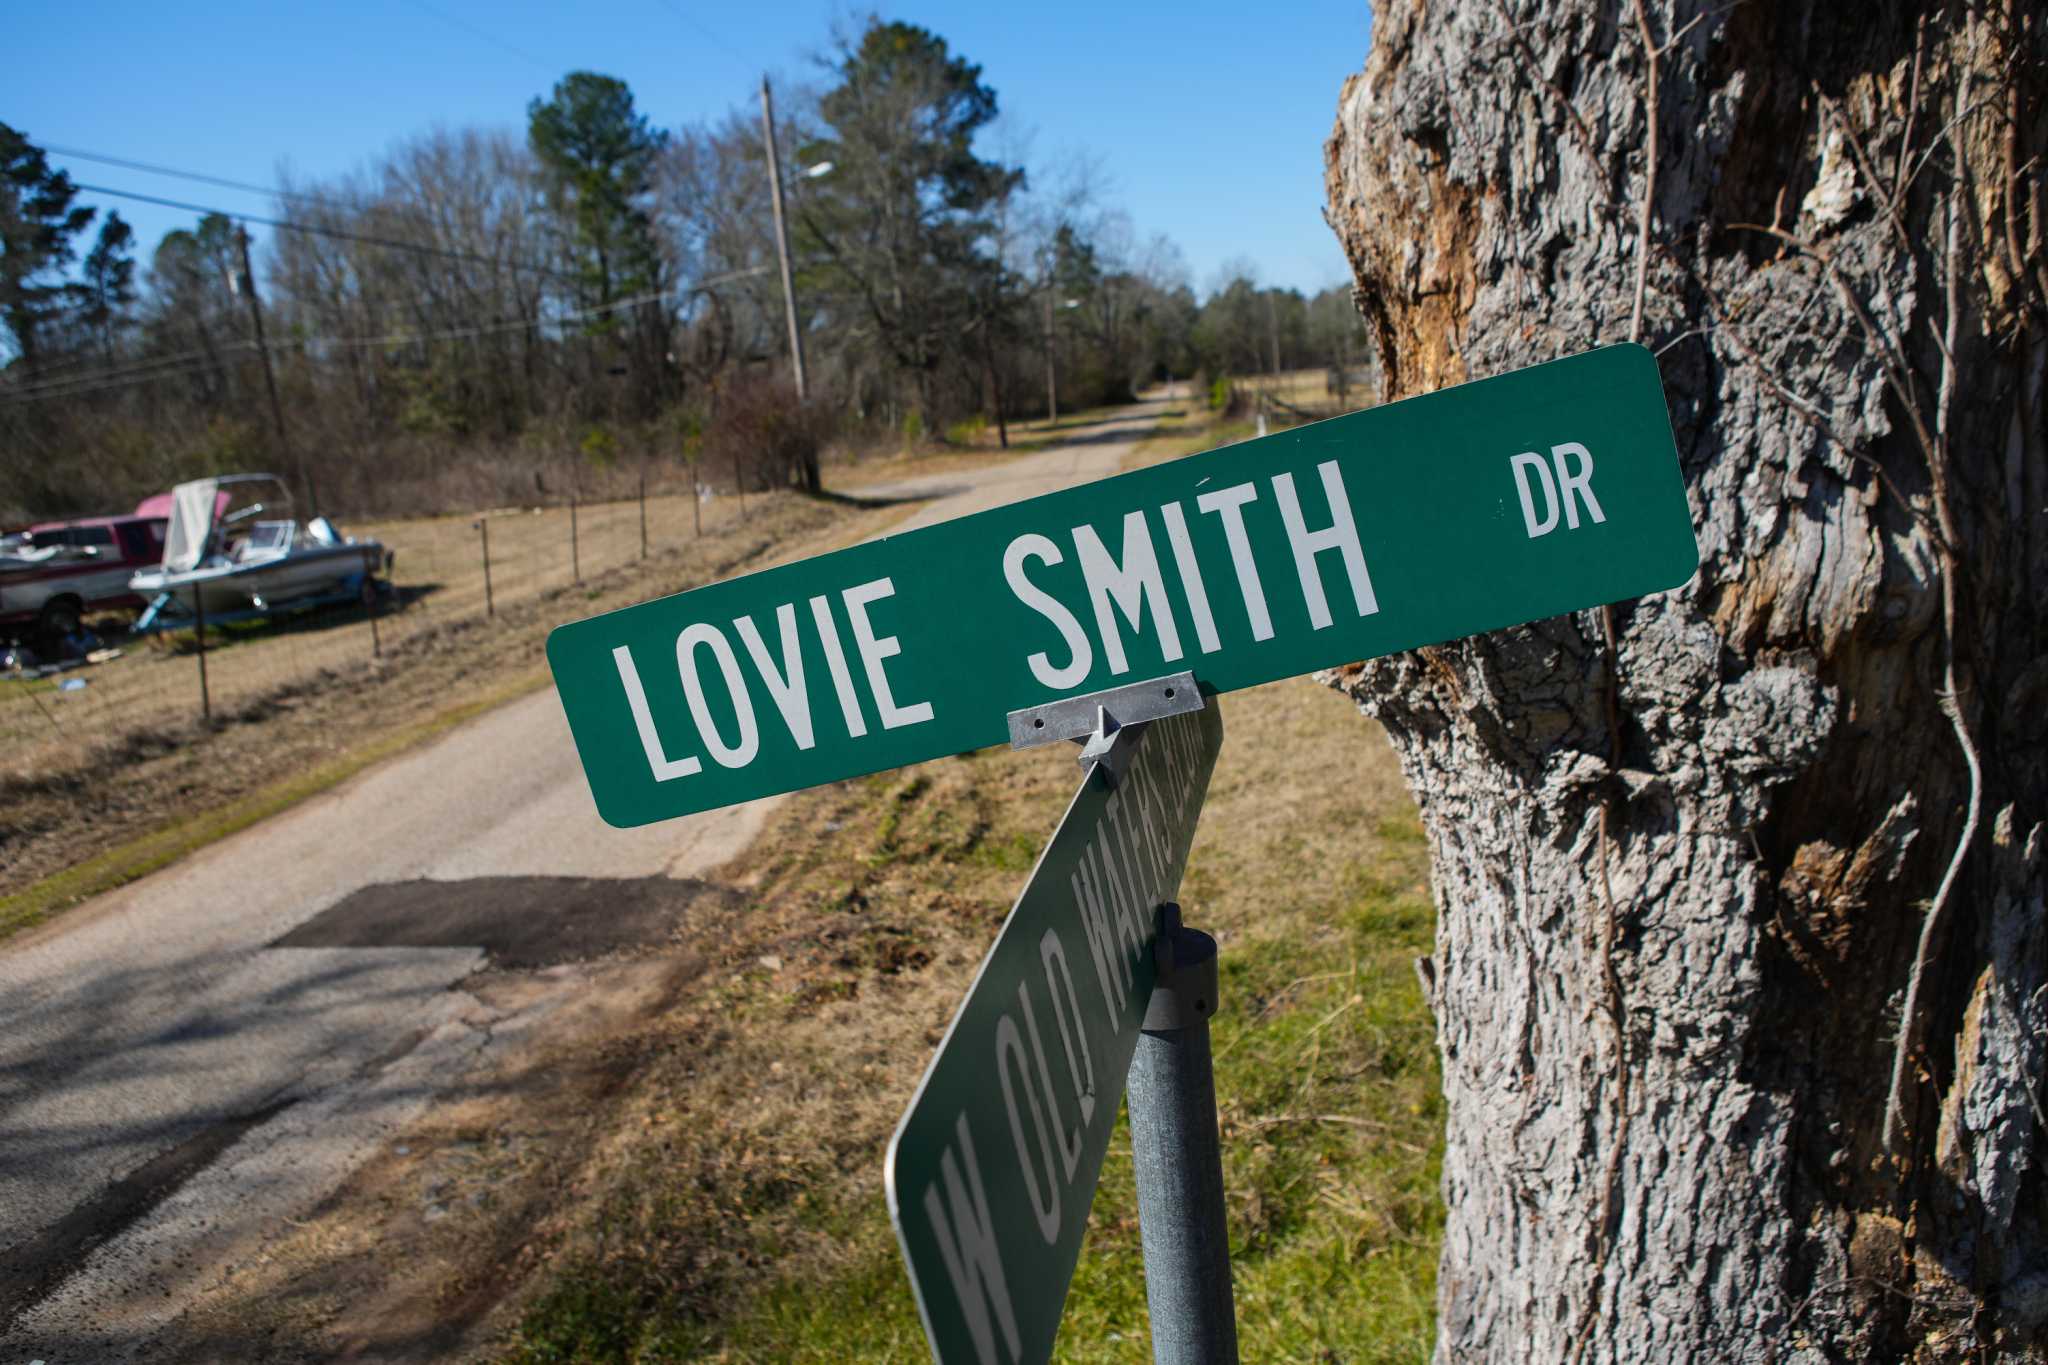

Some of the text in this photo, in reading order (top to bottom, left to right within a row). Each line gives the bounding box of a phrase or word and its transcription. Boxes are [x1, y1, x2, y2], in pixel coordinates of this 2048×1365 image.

[613, 443, 1606, 781] LOVIE SMITH DR
[924, 1109, 1023, 1365] W
[996, 927, 1095, 1245] OLD
[1071, 731, 1172, 1036] WATERS
